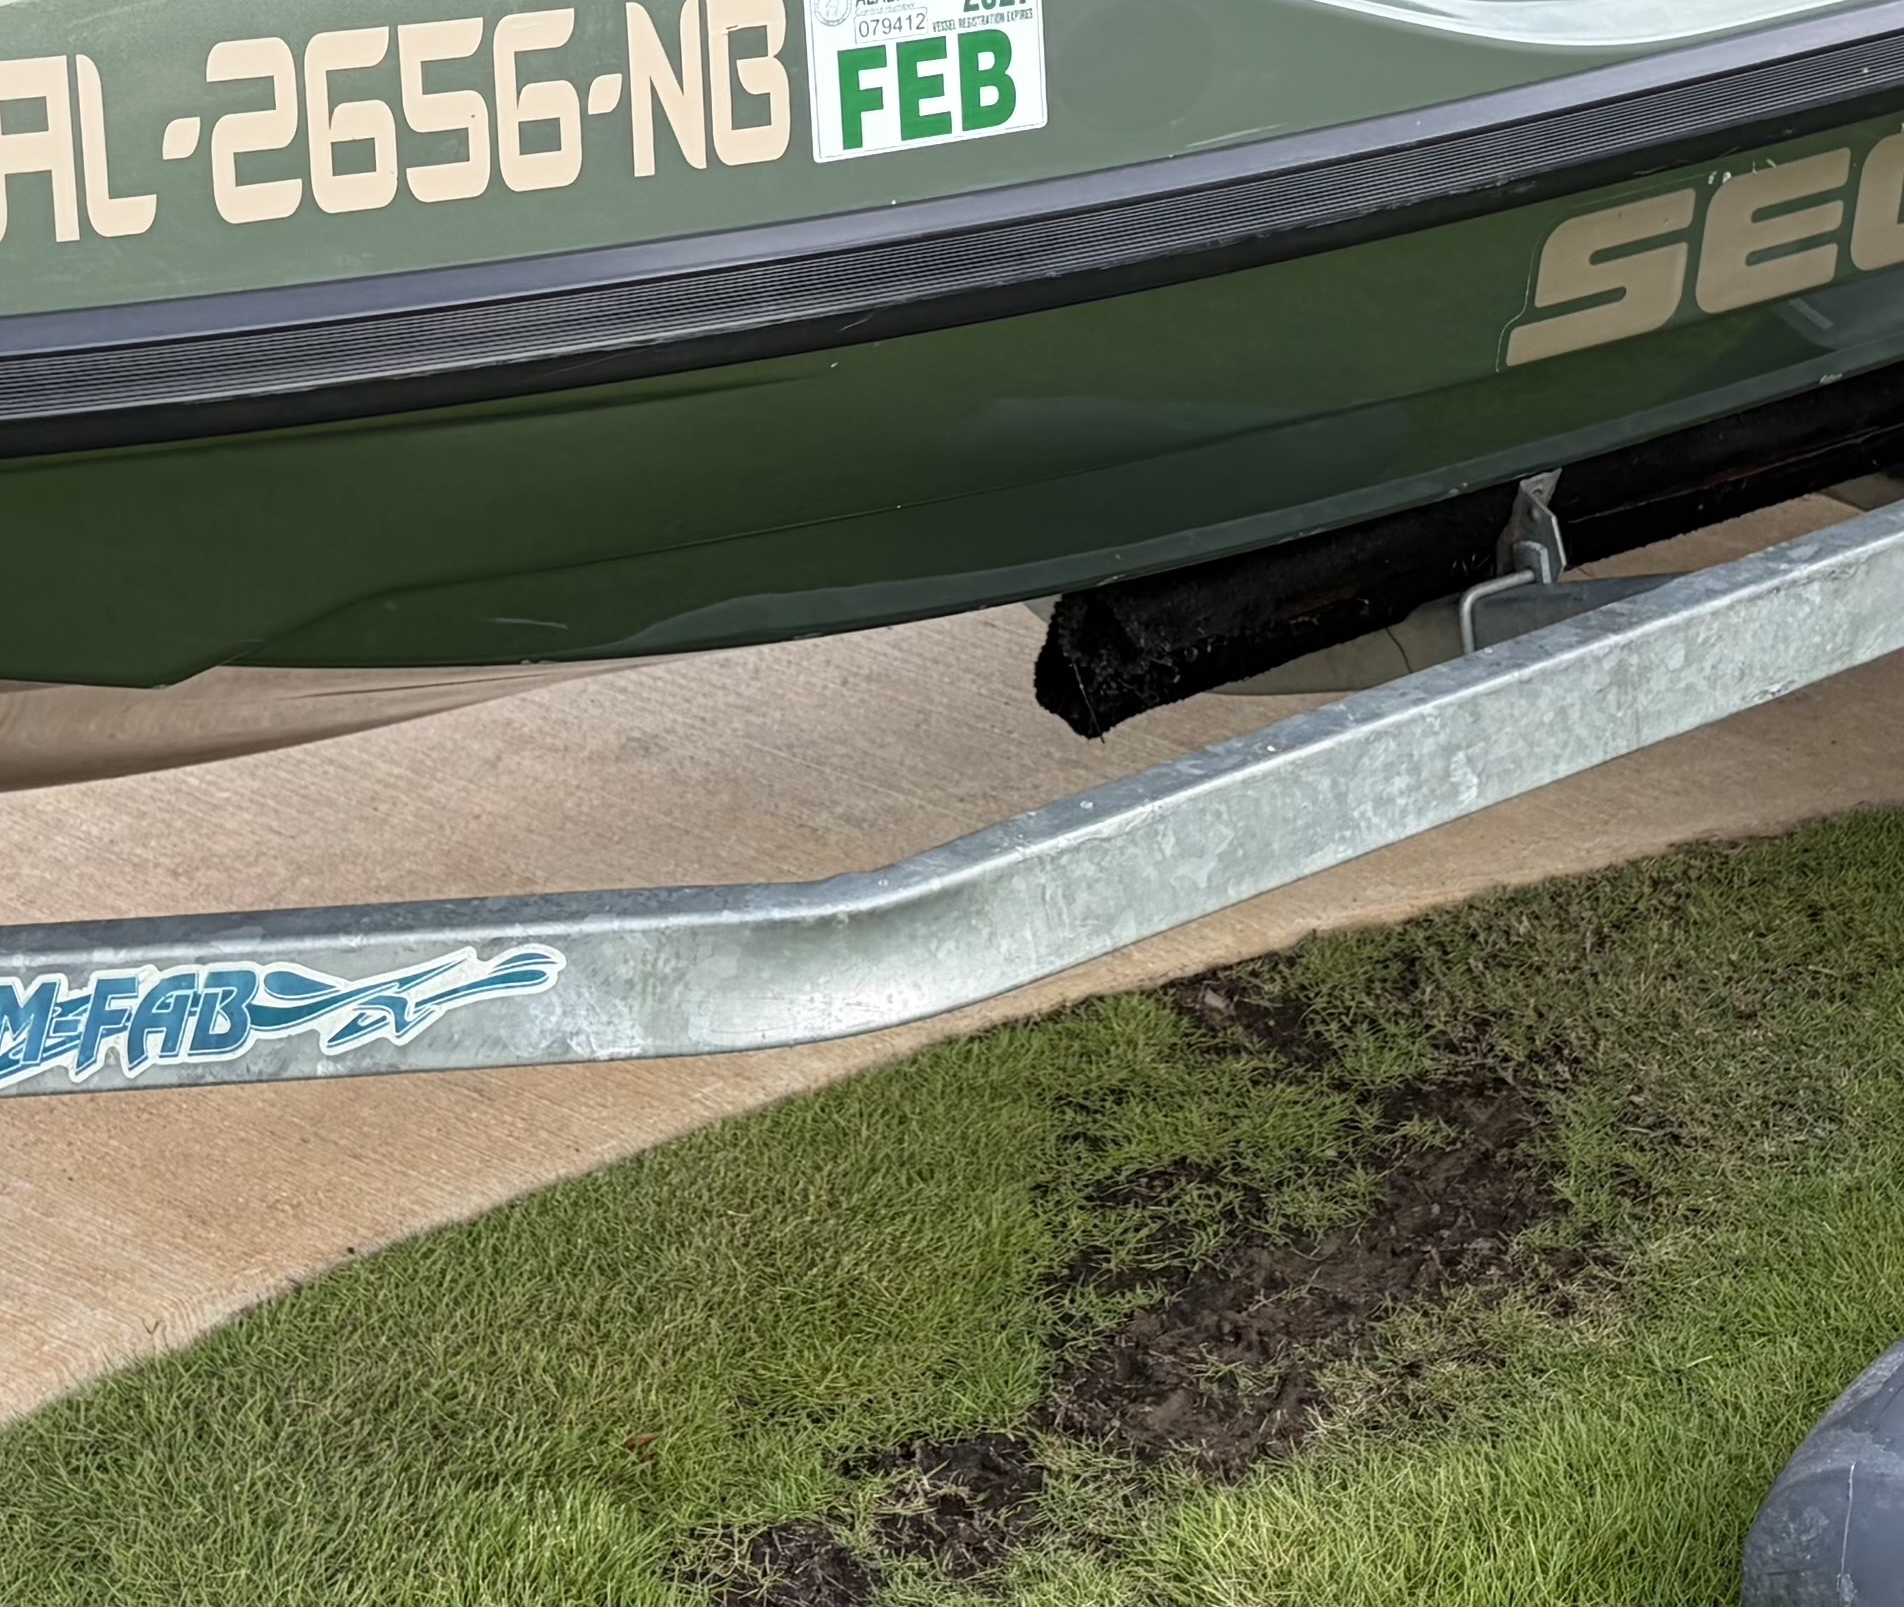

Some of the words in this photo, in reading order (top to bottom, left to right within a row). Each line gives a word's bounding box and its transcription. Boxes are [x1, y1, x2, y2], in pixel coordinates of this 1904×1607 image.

[858, 12, 926, 37] 079412
[932, 19, 956, 32] VESSEL
[958, 12, 1005, 29] REGISTRATION
[1006, 8, 1033, 23] EXPIRES
[837, 29, 1016, 150] FEB
